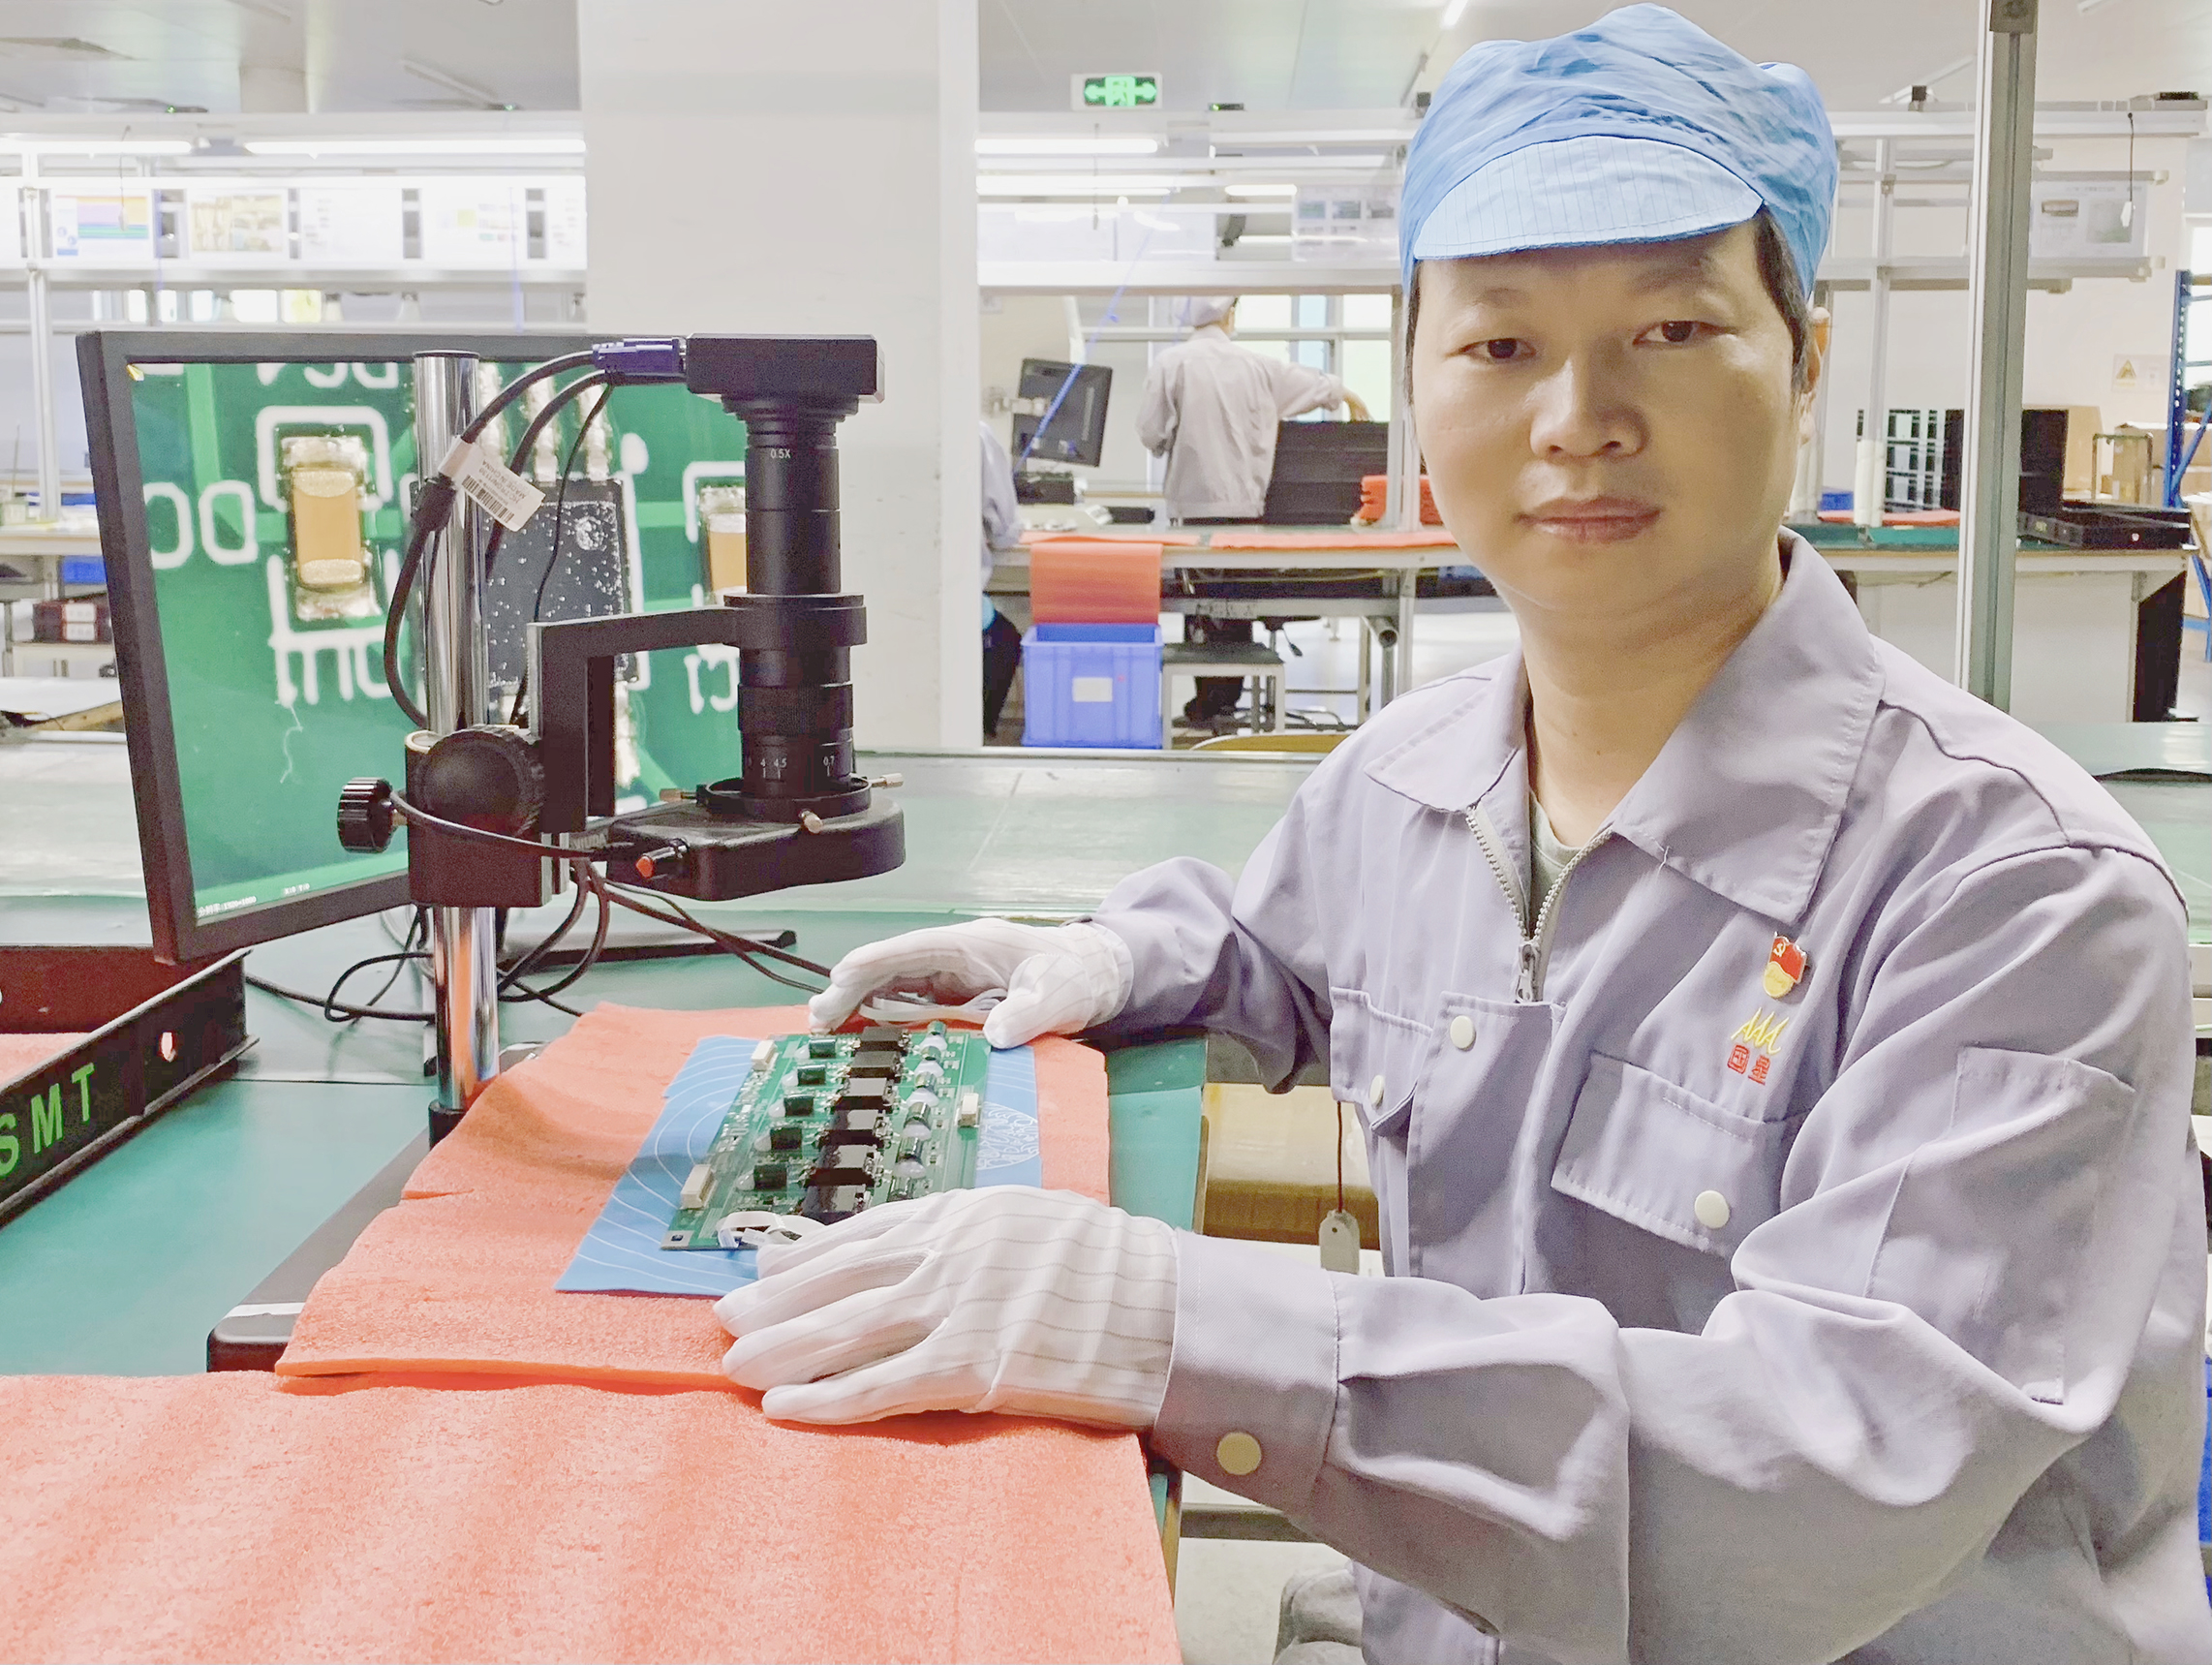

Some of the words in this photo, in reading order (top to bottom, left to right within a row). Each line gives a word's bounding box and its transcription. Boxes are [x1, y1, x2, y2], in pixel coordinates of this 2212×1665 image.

[770, 448, 791, 459] 0.5X
[482, 459, 502, 478] CHINA
[0, 1063, 95, 1178] SMT
